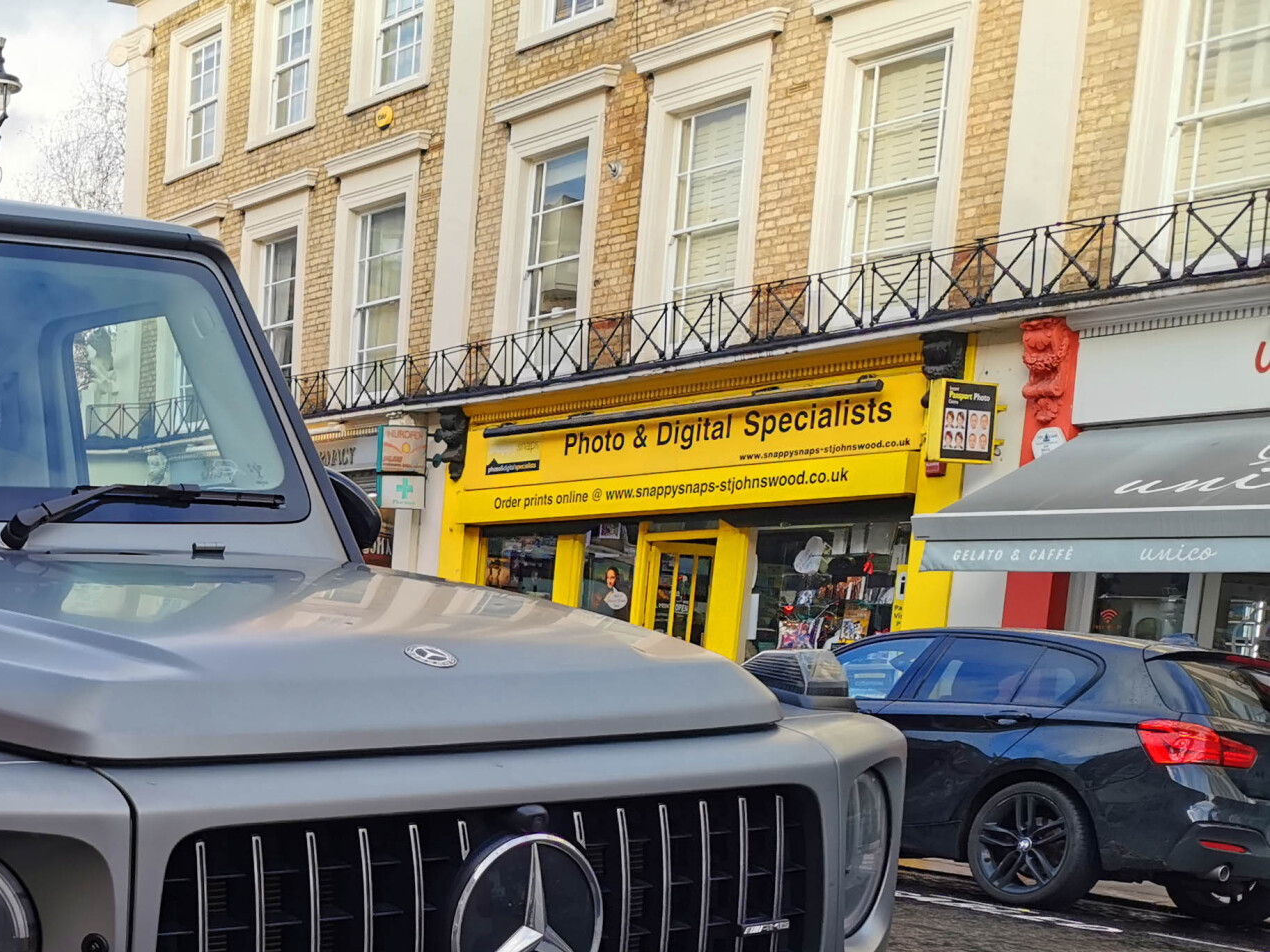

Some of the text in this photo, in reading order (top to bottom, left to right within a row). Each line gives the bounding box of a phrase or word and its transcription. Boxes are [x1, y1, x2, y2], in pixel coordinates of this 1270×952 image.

[564, 398, 892, 456] Photo & Digital Specialists
[739, 437, 911, 461] www.snappysnaps-stjohnswood.co.uk
[494, 467, 849, 510] Order prints online @ www.snappysnaps-stjohnswood.co.uk
[953, 546, 1073, 561] GELATO & CAFFÈ
[1140, 544, 1217, 562] unico
